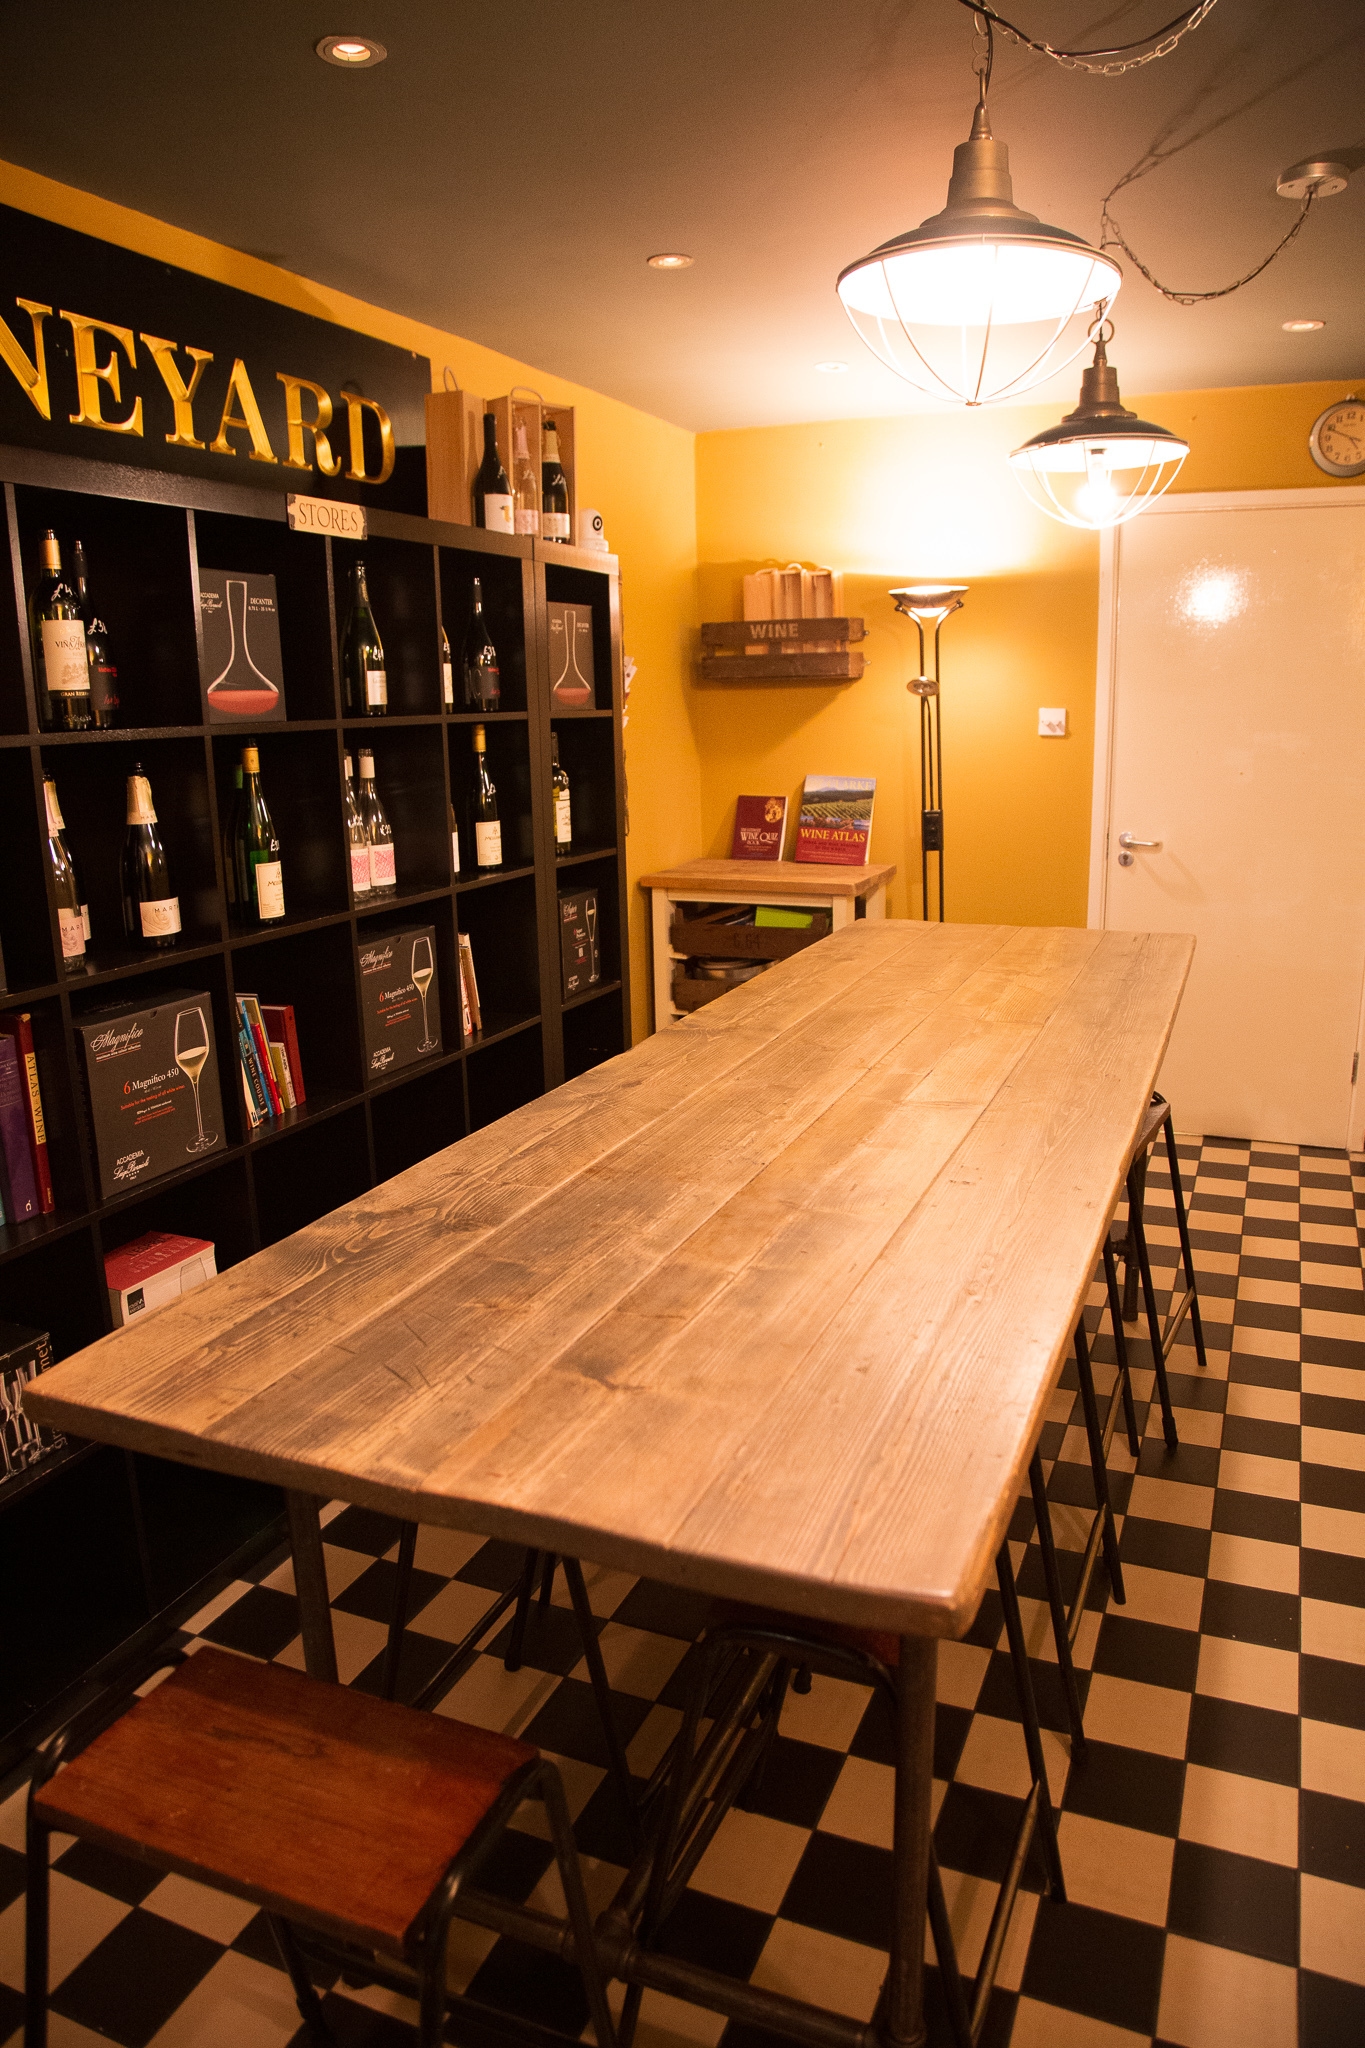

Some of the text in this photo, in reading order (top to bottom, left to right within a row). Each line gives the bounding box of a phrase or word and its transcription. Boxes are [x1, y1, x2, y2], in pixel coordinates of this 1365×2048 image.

[299, 502, 359, 533] STORES
[250, 598, 274, 606] DECANTER
[750, 623, 799, 639] WINE
[740, 831, 779, 844] WINE QUIZ
[800, 828, 866, 843] WINE ATLAS
[379, 983, 415, 1002] 6 Magnifico 450
[90, 1022, 144, 1052] Magnifico
[123, 1080, 131, 1095] 6
[132, 1074, 166, 1091] Magnifico
[166, 1067, 179, 1078] 450
[247, 1057, 257, 1080] WINE
[253, 1079, 265, 1106] COURSE
[26, 1055, 39, 1098] ATLAS
[34, 1106, 46, 1143] WINE
[116, 1149, 144, 1166] ACCADEMIA
